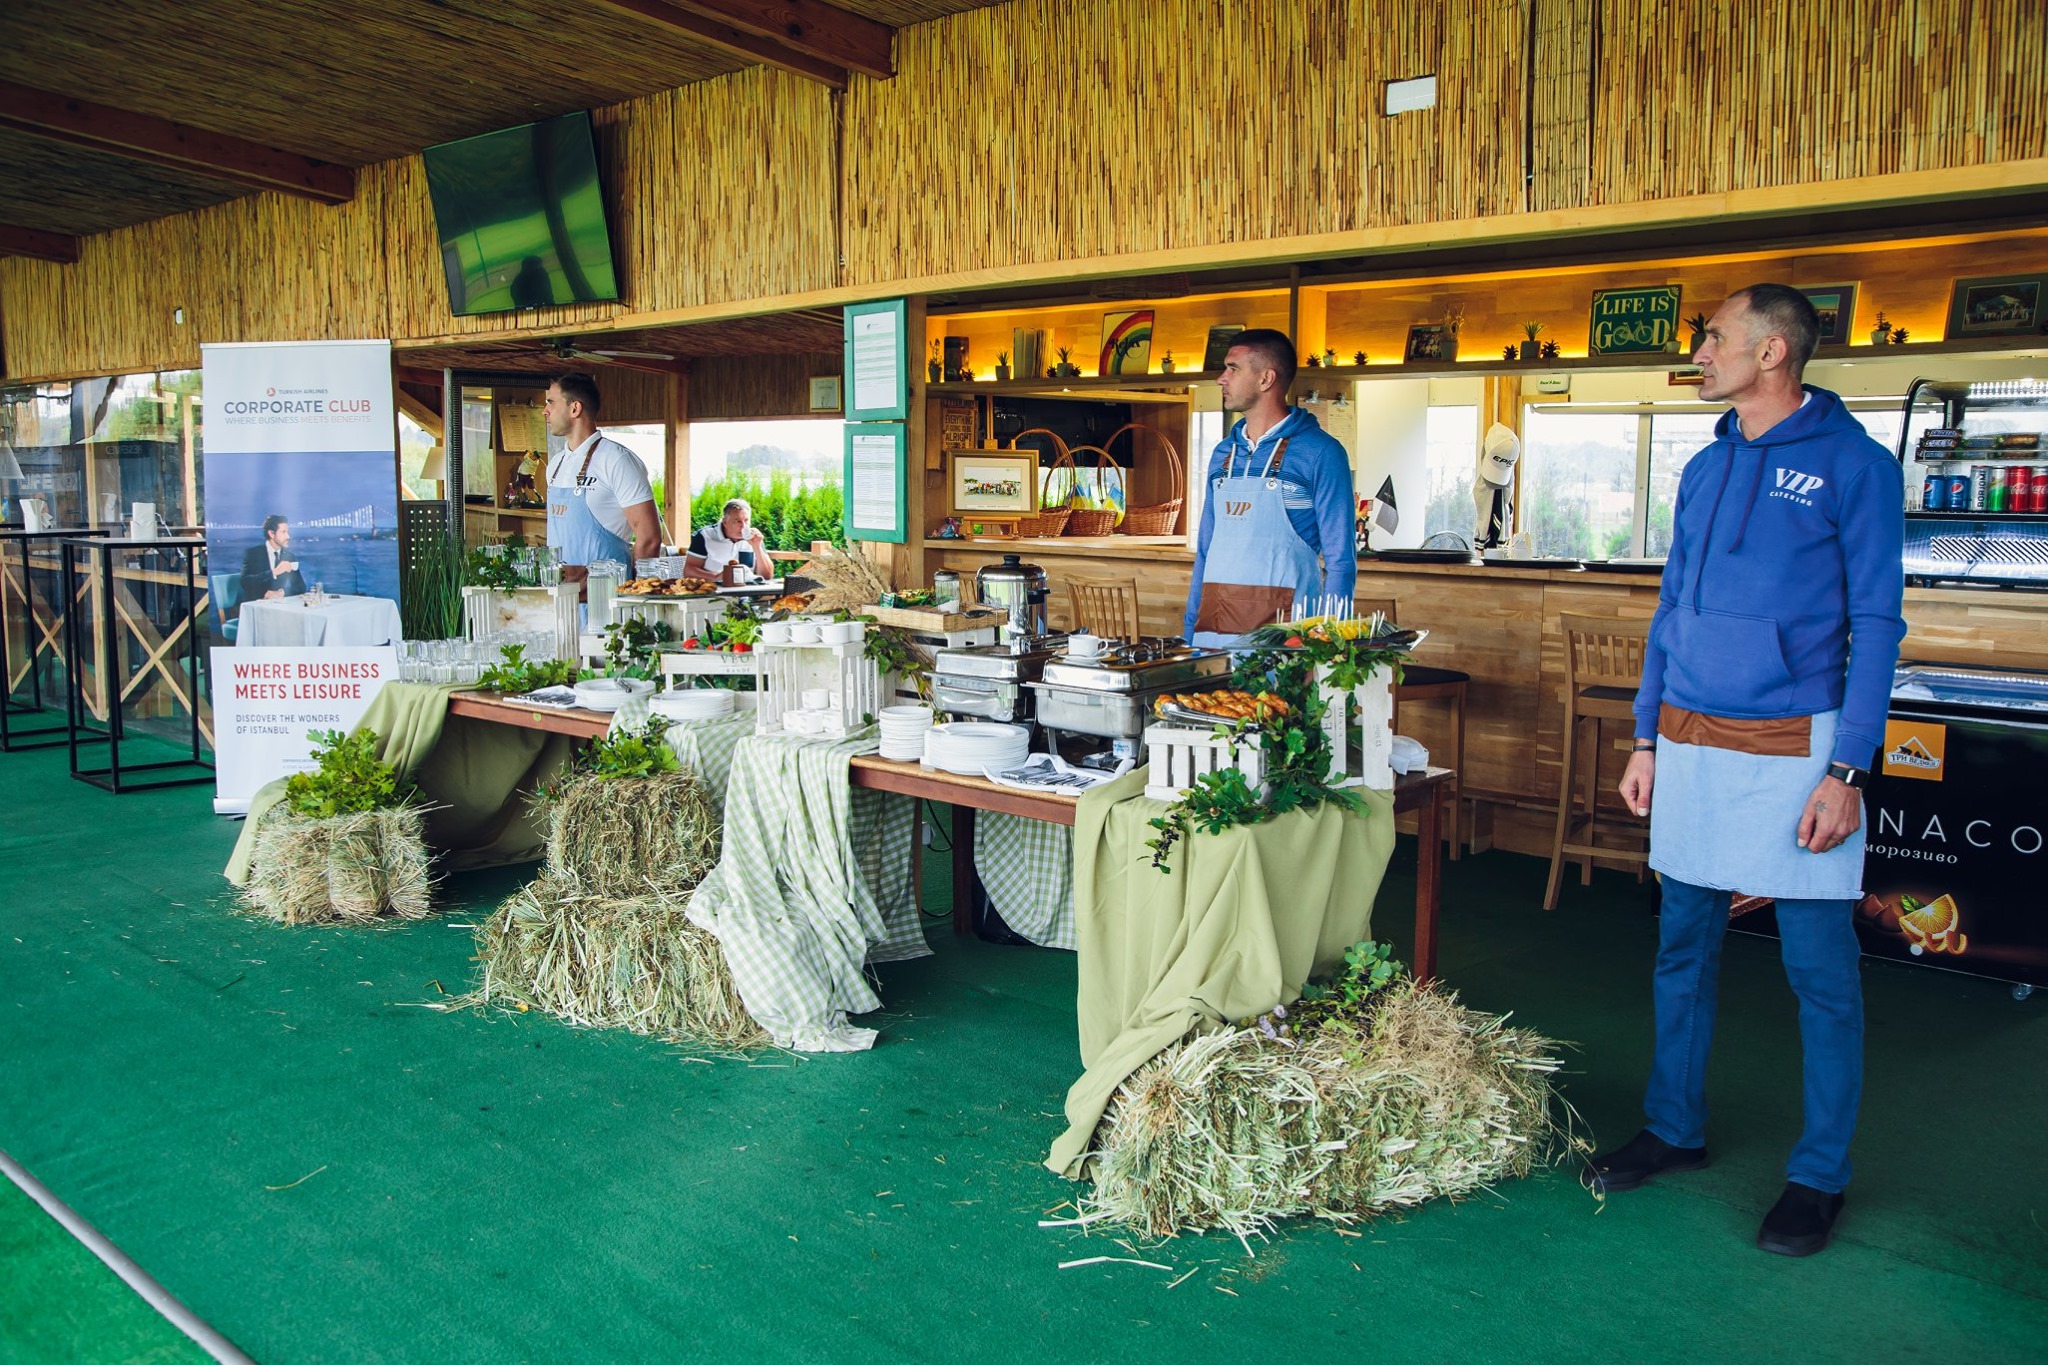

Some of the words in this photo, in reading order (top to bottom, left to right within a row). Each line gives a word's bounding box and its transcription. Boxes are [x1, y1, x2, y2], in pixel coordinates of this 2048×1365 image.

[1602, 297, 1645, 315] LIFE
[1650, 296, 1670, 312] IS
[224, 400, 323, 414] CORPORATE
[329, 399, 371, 413] CLUB
[258, 416, 299, 424] BUSINESS
[331, 415, 371, 423] BENEFITS
[1493, 455, 1515, 466] EPIC
[1776, 467, 1824, 495] VIP
[1769, 491, 1813, 506] CATERING
[551, 504, 567, 515] VIP
[1225, 501, 1252, 516] VIP
[234, 664, 292, 679] WHERE
[298, 663, 380, 679] BUSINESS
[235, 684, 287, 699] MEETS
[293, 684, 361, 699] LEISURE
[235, 714, 277, 723] DISCOVER
[280, 714, 295, 722] THE
[298, 714, 340, 722] WONDERS
[236, 726, 247, 734] OF
[250, 726, 290, 734] ISTANBUL
[1891, 753, 1908, 761] ТРИ
[1864, 843, 1958, 864] морозиво
